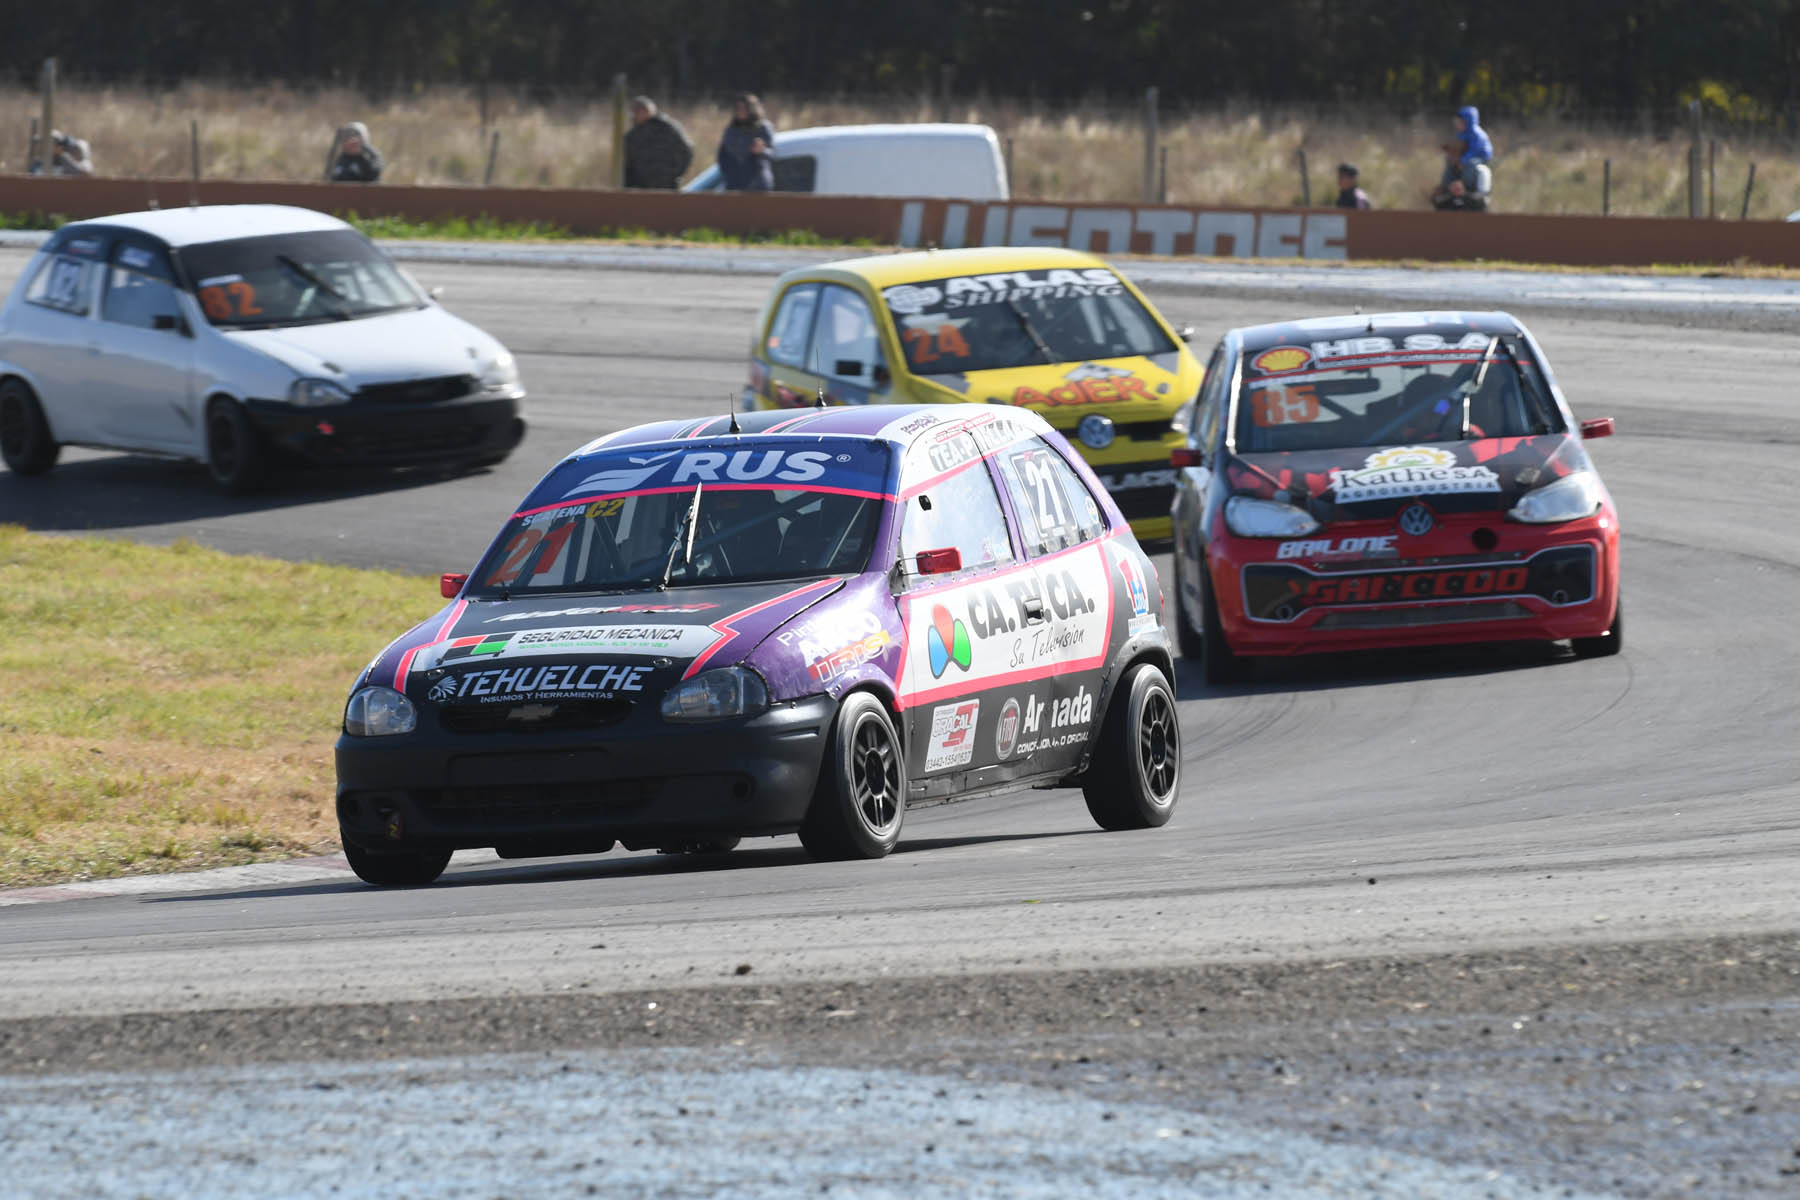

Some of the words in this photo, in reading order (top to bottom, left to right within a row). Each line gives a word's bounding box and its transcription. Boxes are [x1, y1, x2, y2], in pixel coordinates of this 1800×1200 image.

[944, 284, 1124, 309] SHIPPING
[946, 268, 1120, 295] ATLAS
[201, 281, 264, 320] 82
[903, 324, 971, 364] 24
[1310, 336, 1396, 359] HB
[1251, 384, 1320, 428] 85
[671, 449, 833, 483] RUS
[1340, 467, 1449, 489] Kathe
[584, 498, 625, 519] C2
[1027, 459, 1066, 529] 21
[484, 520, 578, 588] 21
[518, 629, 605, 644] SEGURIDAD
[603, 628, 684, 641] MECANICA
[457, 665, 655, 697] TEHUELCHE
[480, 692, 524, 704] INSUMOS
[534, 690, 614, 700] HERRAMIENTAS
[1022, 685, 1093, 734] Arada
